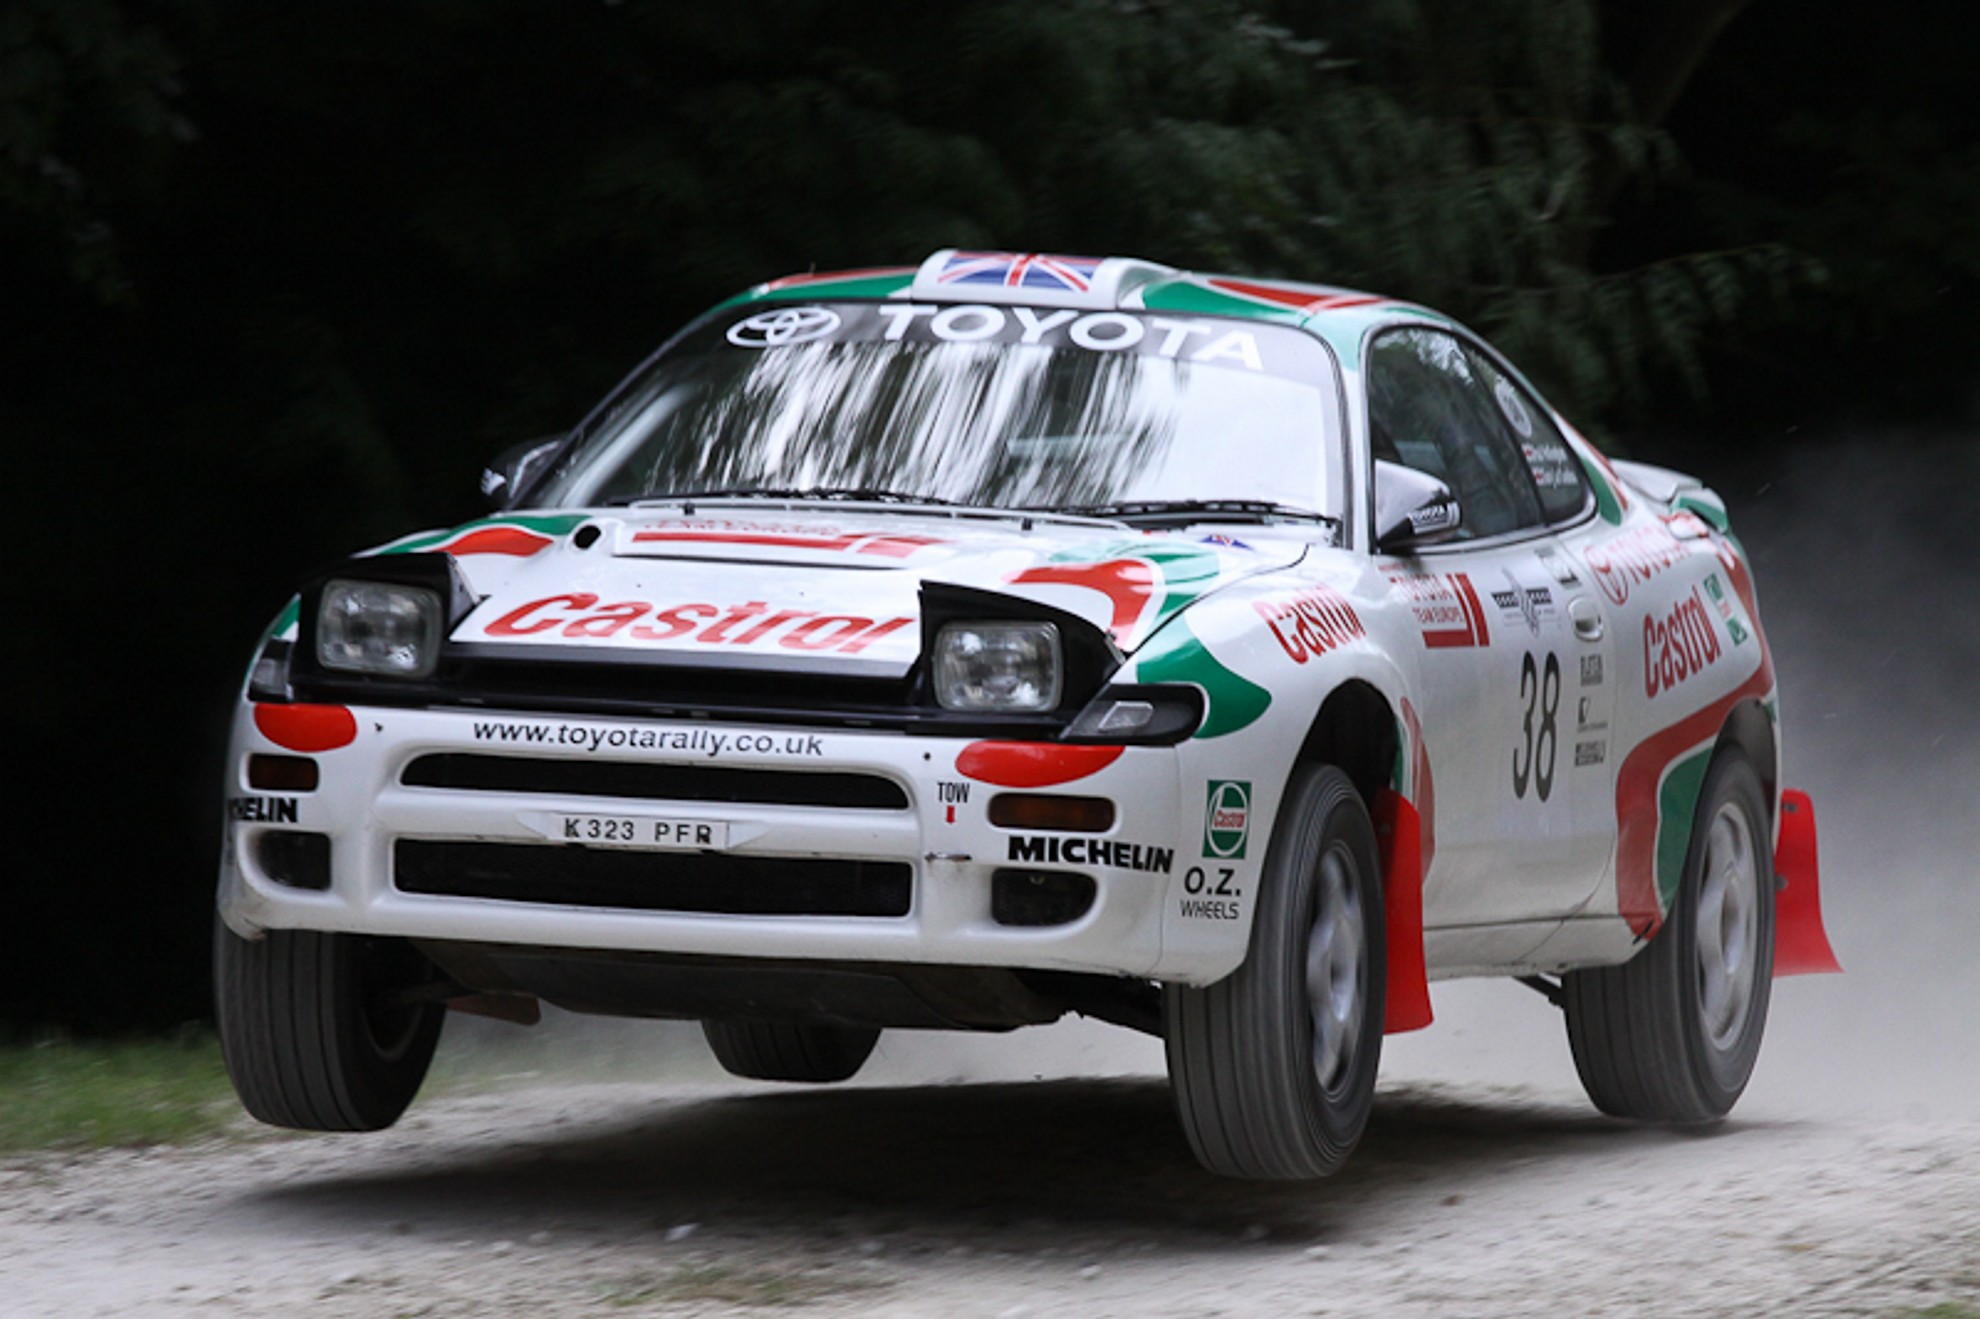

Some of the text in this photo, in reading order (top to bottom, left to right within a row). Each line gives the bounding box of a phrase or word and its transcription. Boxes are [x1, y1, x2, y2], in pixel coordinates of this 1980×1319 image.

[880, 303, 1264, 370] TOYOTA
[483, 592, 917, 654] Castrol
[1252, 583, 1366, 665] Castrol
[1642, 584, 1722, 699] Castrol
[473, 719, 825, 757] www.toyotarally.co.uk
[1513, 650, 1560, 802] 38
[937, 782, 970, 804] TOW
[654, 822, 712, 844] PFR
[1008, 835, 1174, 874] MICHELIN
[1184, 867, 1241, 898] O.Z.
[1180, 901, 1240, 920] WHEELS
